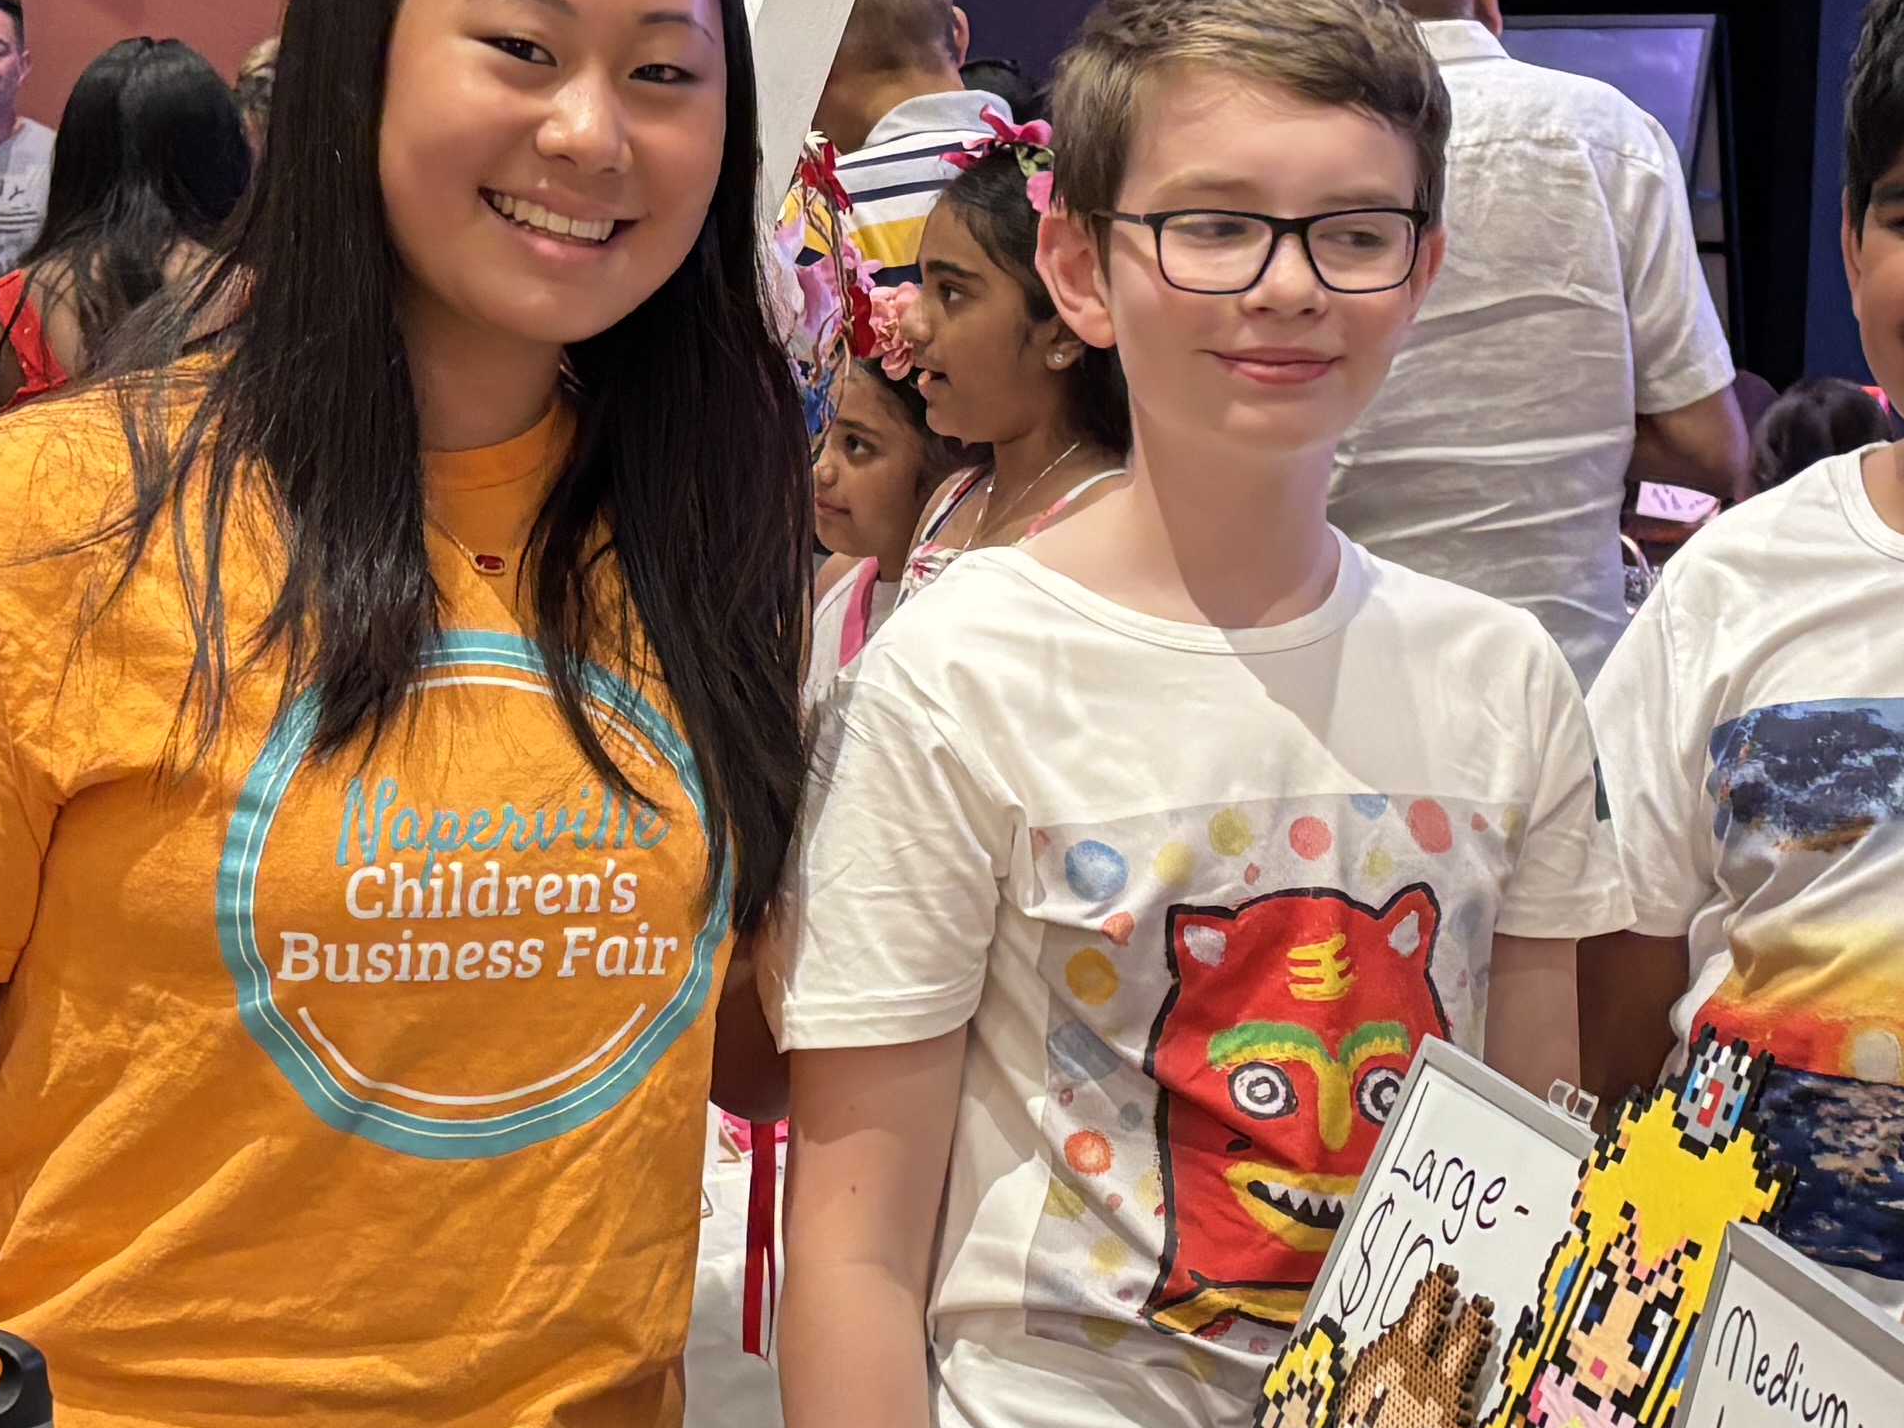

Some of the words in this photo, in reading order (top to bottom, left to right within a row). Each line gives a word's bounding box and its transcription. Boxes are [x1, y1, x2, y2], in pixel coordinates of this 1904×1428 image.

[335, 776, 670, 889] Naperville
[344, 859, 638, 920] Children's
[276, 929, 545, 983] Business
[556, 923, 678, 978] Fair
